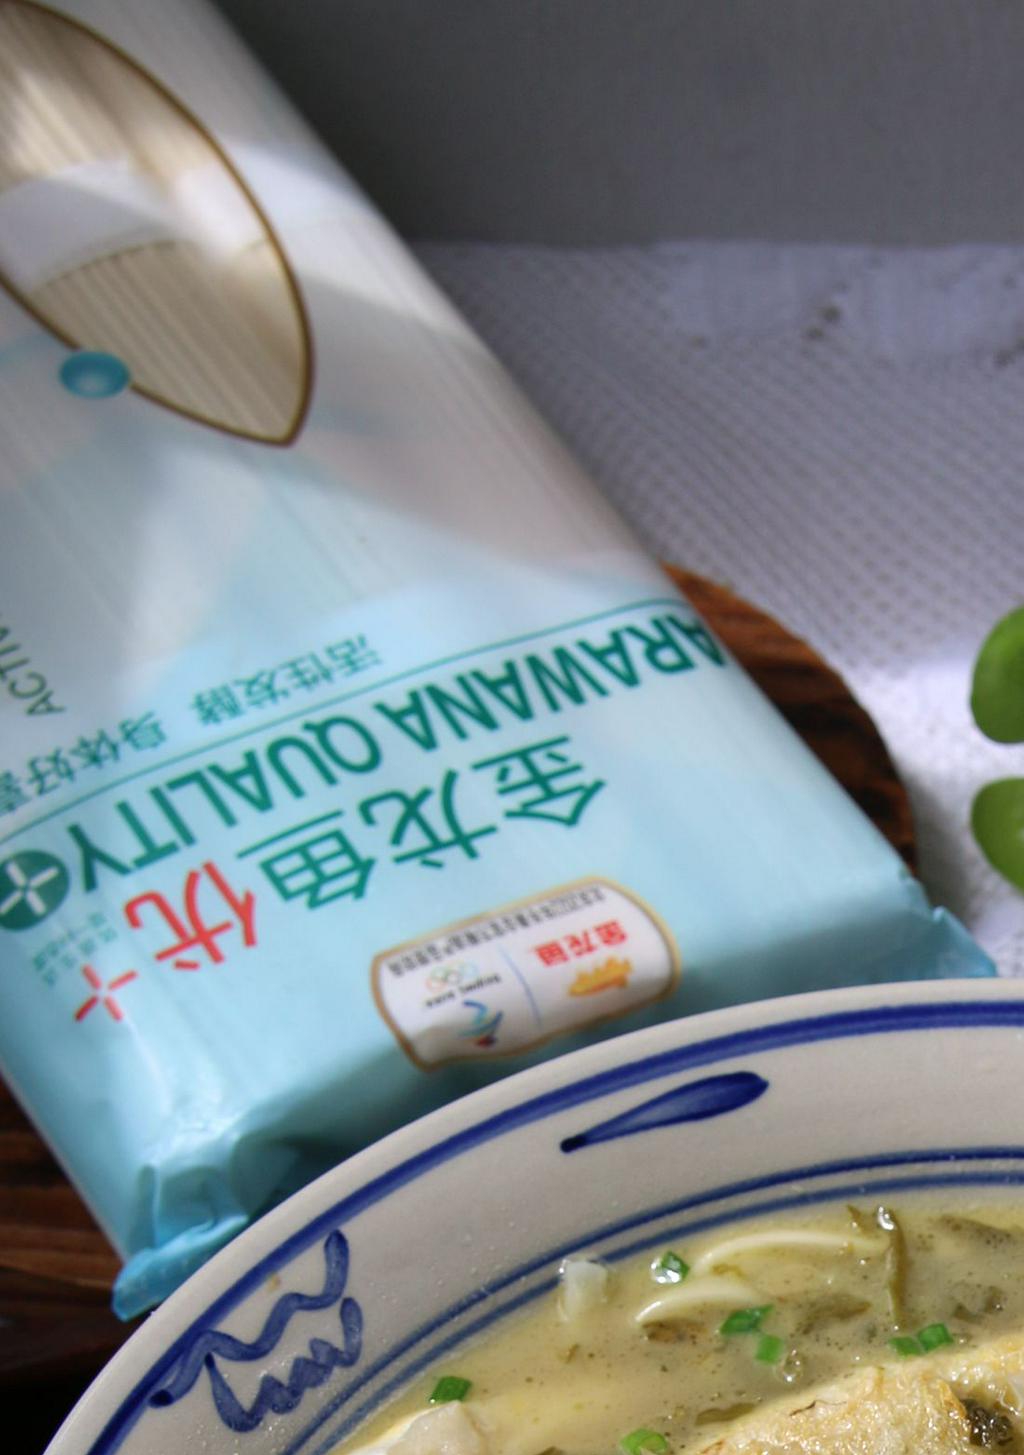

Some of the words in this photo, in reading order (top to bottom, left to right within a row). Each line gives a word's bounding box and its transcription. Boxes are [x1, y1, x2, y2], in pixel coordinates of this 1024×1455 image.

[193, 635, 383, 725] 活性发酵
[374, 614, 728, 753] ARAWANA
[67, 715, 383, 893] QUALITY
